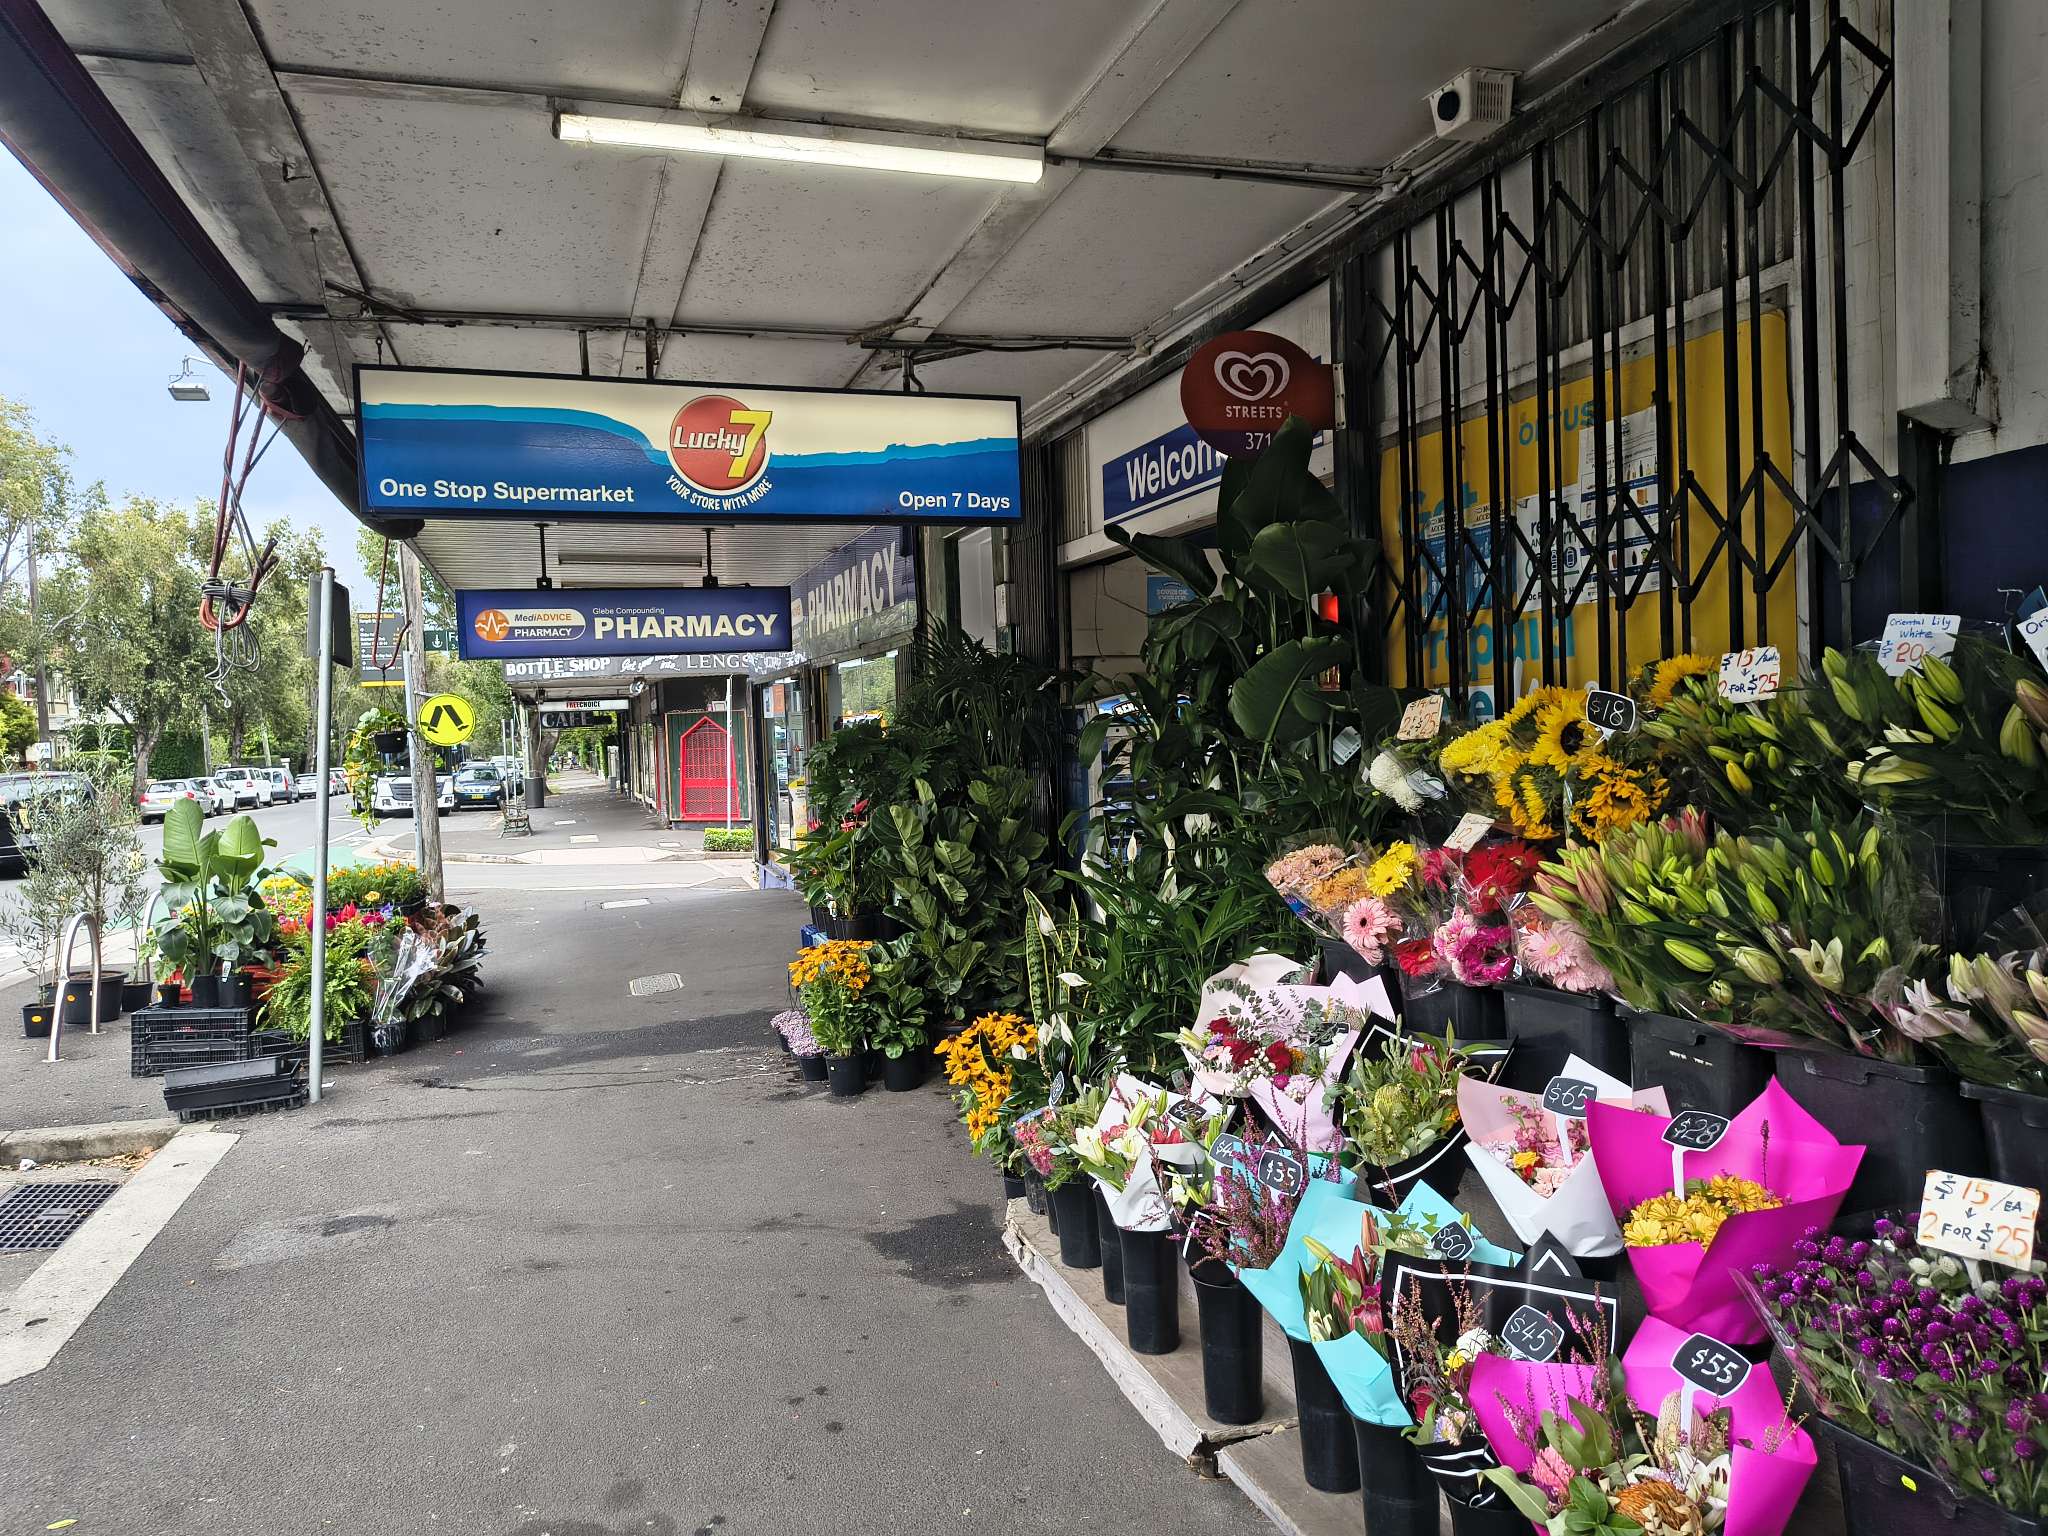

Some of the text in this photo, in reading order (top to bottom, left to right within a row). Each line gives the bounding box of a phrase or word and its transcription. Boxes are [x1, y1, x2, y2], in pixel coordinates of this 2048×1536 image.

[1225, 405, 1283, 419] STREETS
[673, 409, 773, 478] Lucky 7
[379, 478, 635, 504] One Stop Supermarket
[665, 474, 774, 511] YOUR STORE WITH MORE
[899, 491, 1010, 512] Open 7 Days
[807, 540, 896, 640] PHARMACY
[514, 612, 573, 624] MediADVICE
[615, 607, 665, 616] Compounding
[514, 627, 572, 638] PHARMACY
[594, 613, 779, 640] PHARMACY
[506, 658, 611, 676] BOTTLE SHOP
[1728, 683, 1746, 694] FOR
[1747, 672, 1778, 695] $25
[541, 711, 593, 728] CAFE
[1592, 698, 1624, 727] $18
[1548, 1083, 1596, 1111] $65
[1674, 1117, 1722, 1145] $28
[1266, 1159, 1296, 1187] $35
[1437, 1226, 1467, 1260] $60
[1919, 1210, 2031, 1258] 2 FOR $25
[1510, 1313, 1554, 1352] $45
[1690, 1348, 1740, 1384] $55
